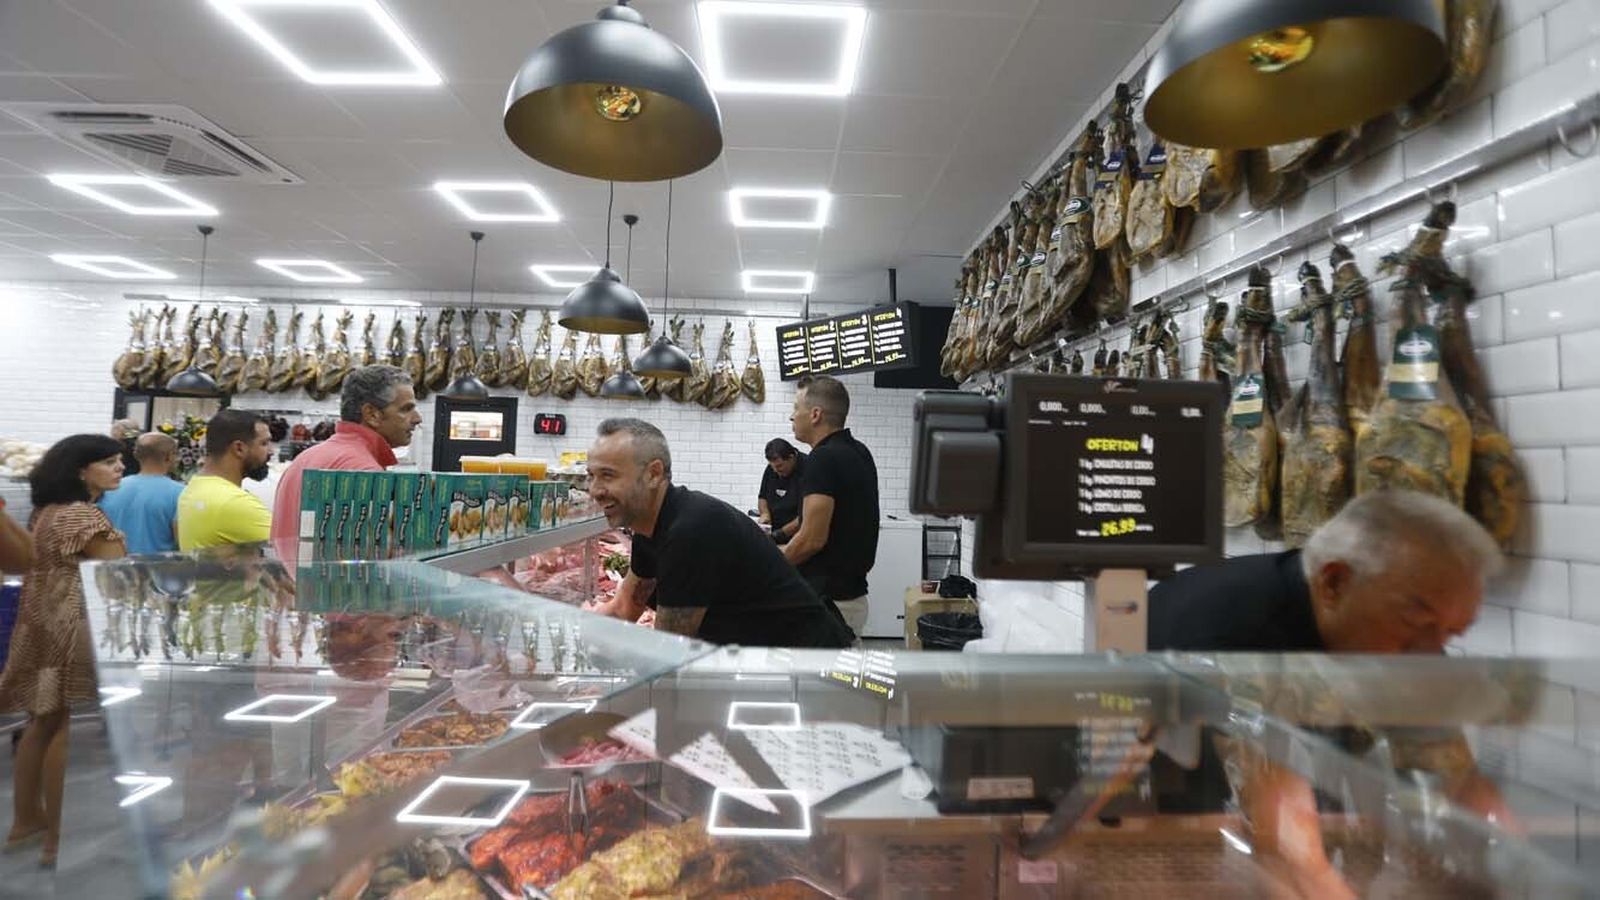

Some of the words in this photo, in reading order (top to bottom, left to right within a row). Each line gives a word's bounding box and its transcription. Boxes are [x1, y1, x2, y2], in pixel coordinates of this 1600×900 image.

[541, 419, 560, 432] 41
[1086, 438, 1138, 451] OFERTON
[1141, 433, 1154, 454] 4
